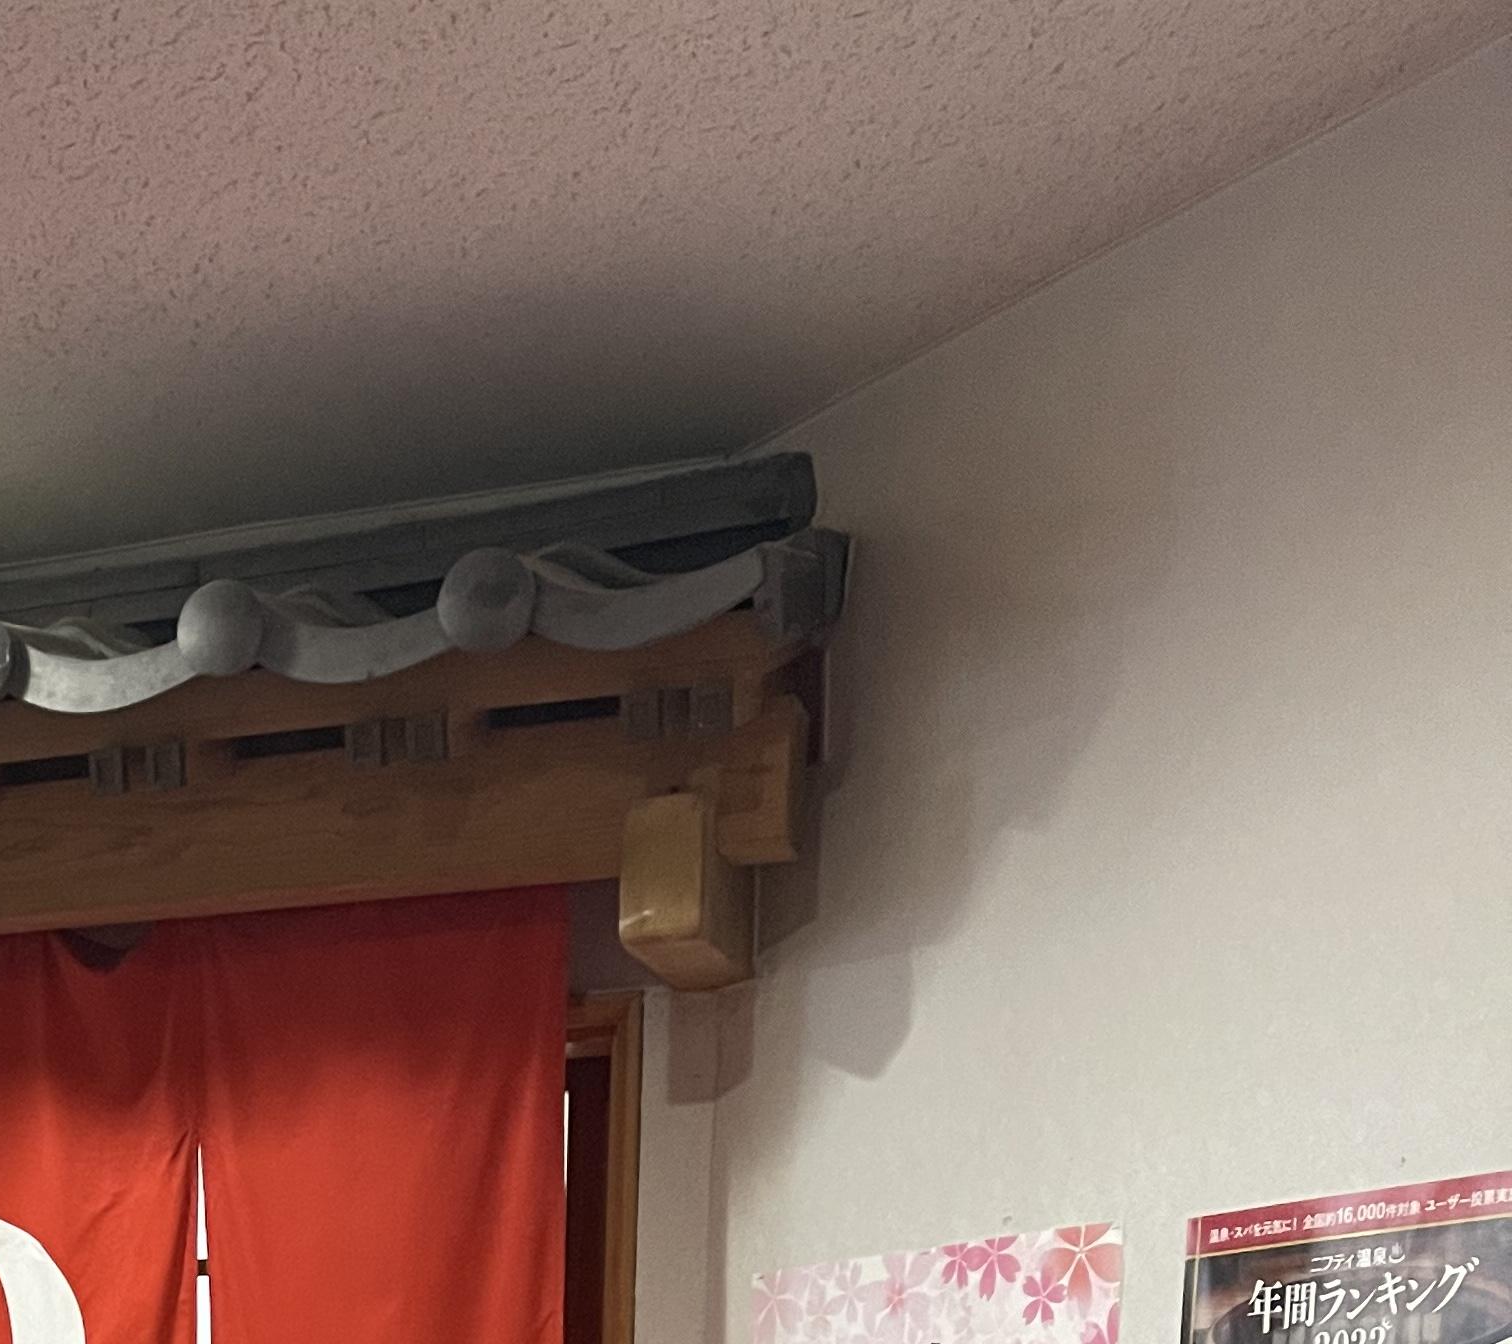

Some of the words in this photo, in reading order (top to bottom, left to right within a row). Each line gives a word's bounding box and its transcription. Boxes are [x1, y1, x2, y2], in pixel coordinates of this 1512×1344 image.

[1310, 1246, 1387, 1273] ニフティ温泉
[1246, 1256, 1480, 1334] 年間ランキング
